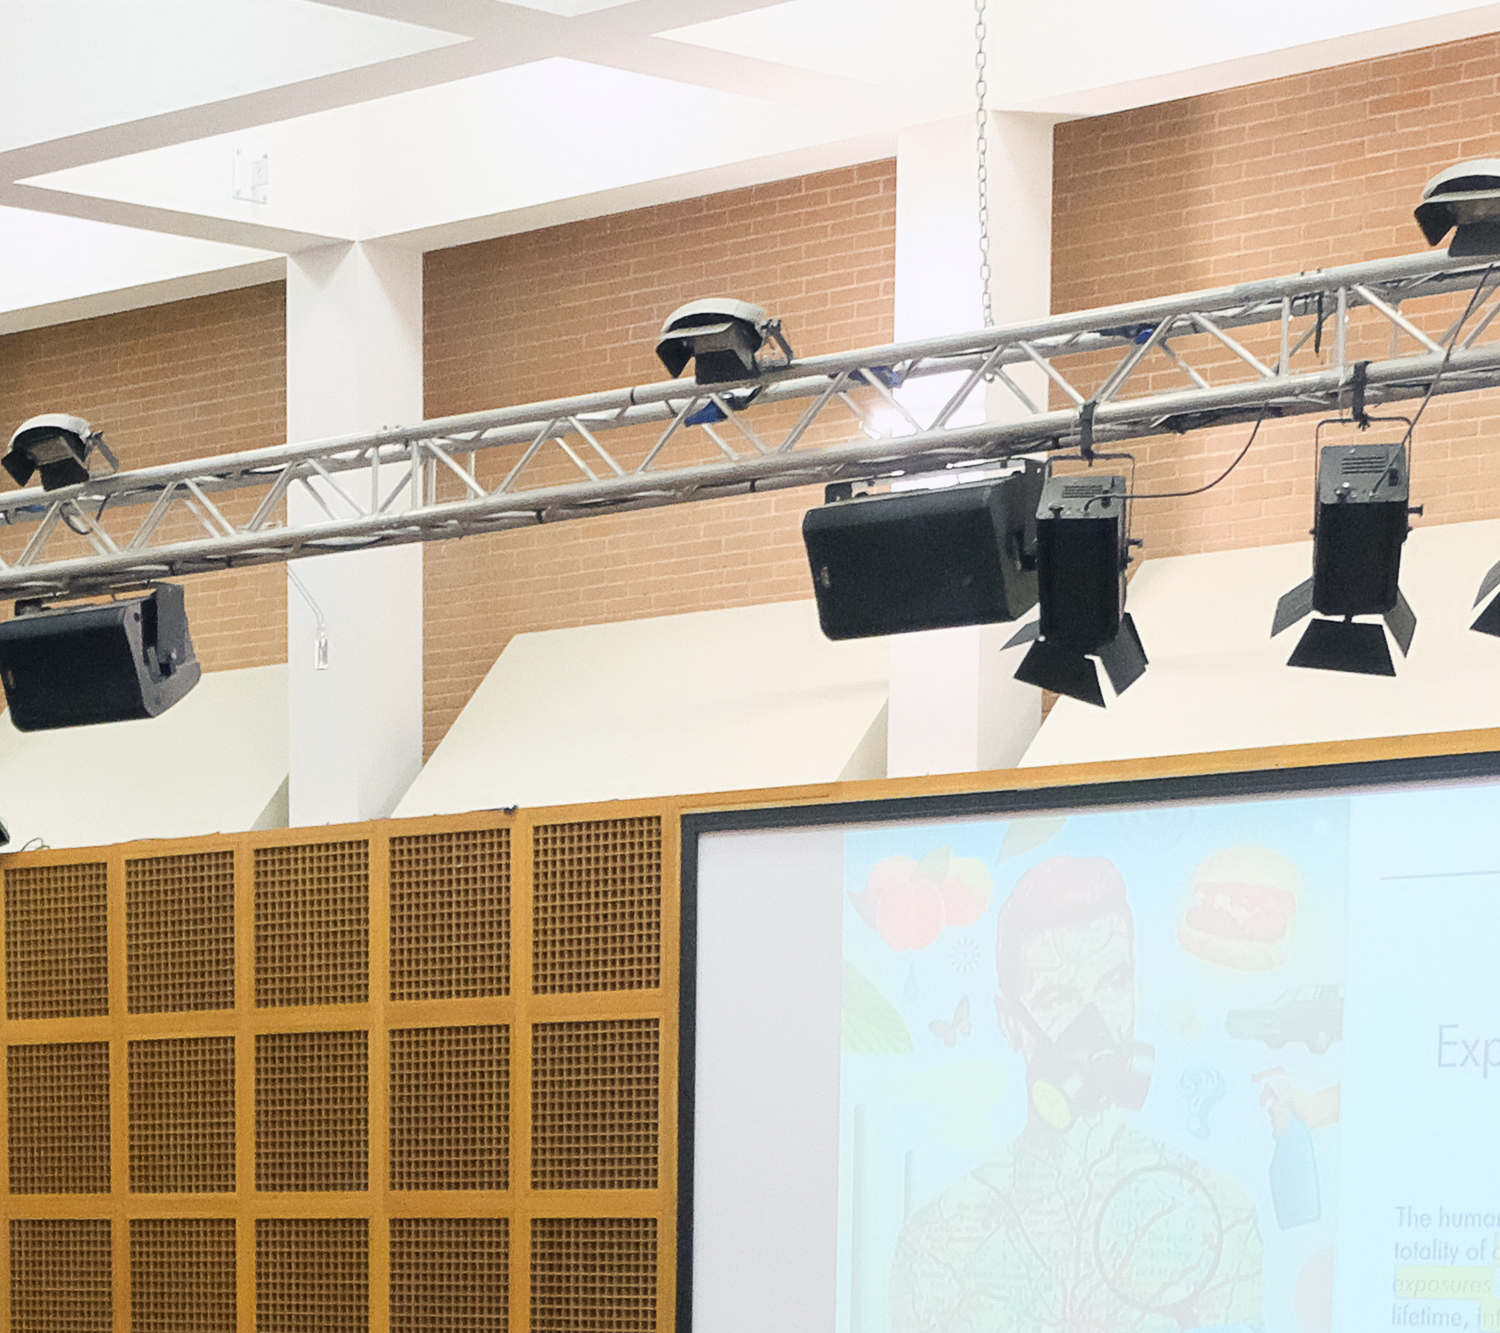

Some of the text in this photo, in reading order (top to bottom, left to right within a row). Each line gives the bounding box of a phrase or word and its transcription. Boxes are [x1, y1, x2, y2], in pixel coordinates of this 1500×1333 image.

[1396, 1205, 1431, 1228] The
[1394, 1238, 1458, 1265] totality
[1465, 1239, 1486, 1260] of
[1392, 1277, 1492, 1297] exposures
[1391, 1304, 1469, 1330] lifetime,
